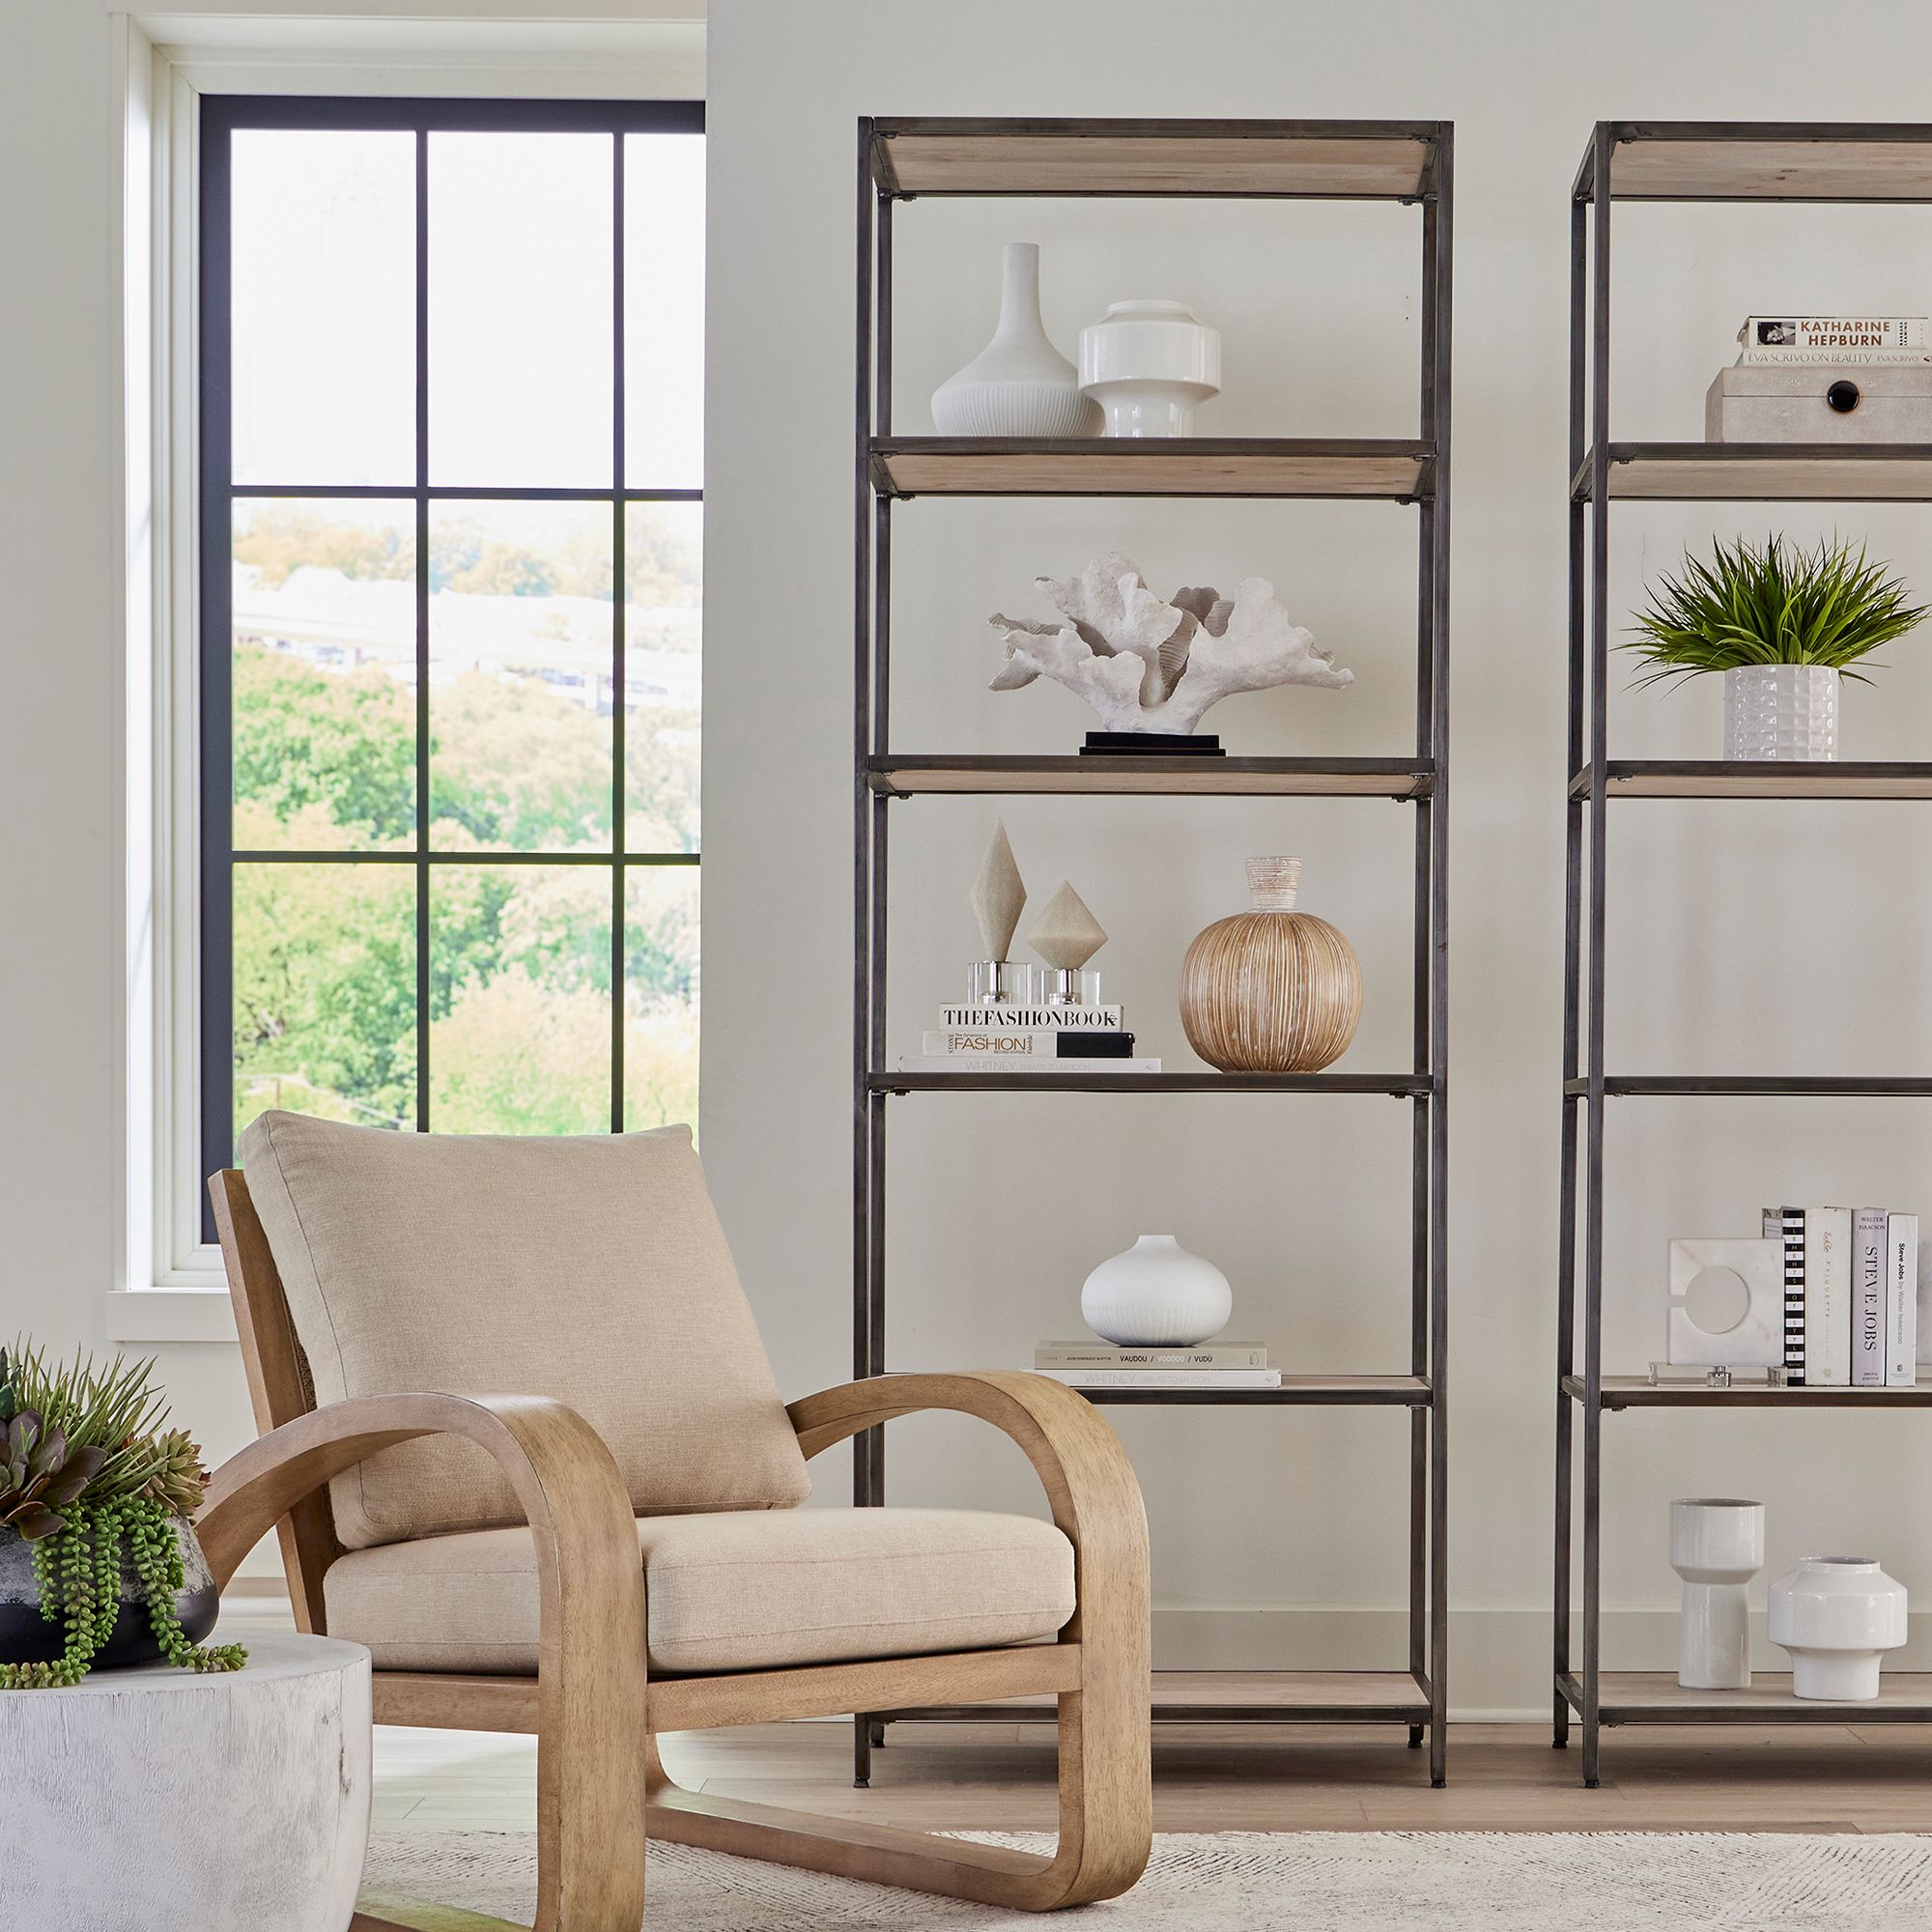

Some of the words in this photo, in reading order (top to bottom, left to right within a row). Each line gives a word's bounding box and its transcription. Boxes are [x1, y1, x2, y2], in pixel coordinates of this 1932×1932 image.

[1801, 322, 1889, 331] KATHARINE
[1808, 335, 1882, 346] HEPBURN
[1748, 354, 1768, 362] EVA
[1771, 354, 1809, 363] SCRIVO
[1811, 354, 1830, 363] ON
[1832, 354, 1873, 363] BEAUTY
[954, 1037, 1026, 1051] FASHION
[966, 1060, 1016, 1071] WHITNEY
[1864, 1246, 1878, 1303] STEVE
[1897, 1281, 1904, 1290] by
[1863, 1309, 1877, 1350] JOBS
[1084, 1374, 1136, 1384] WHITNEY
